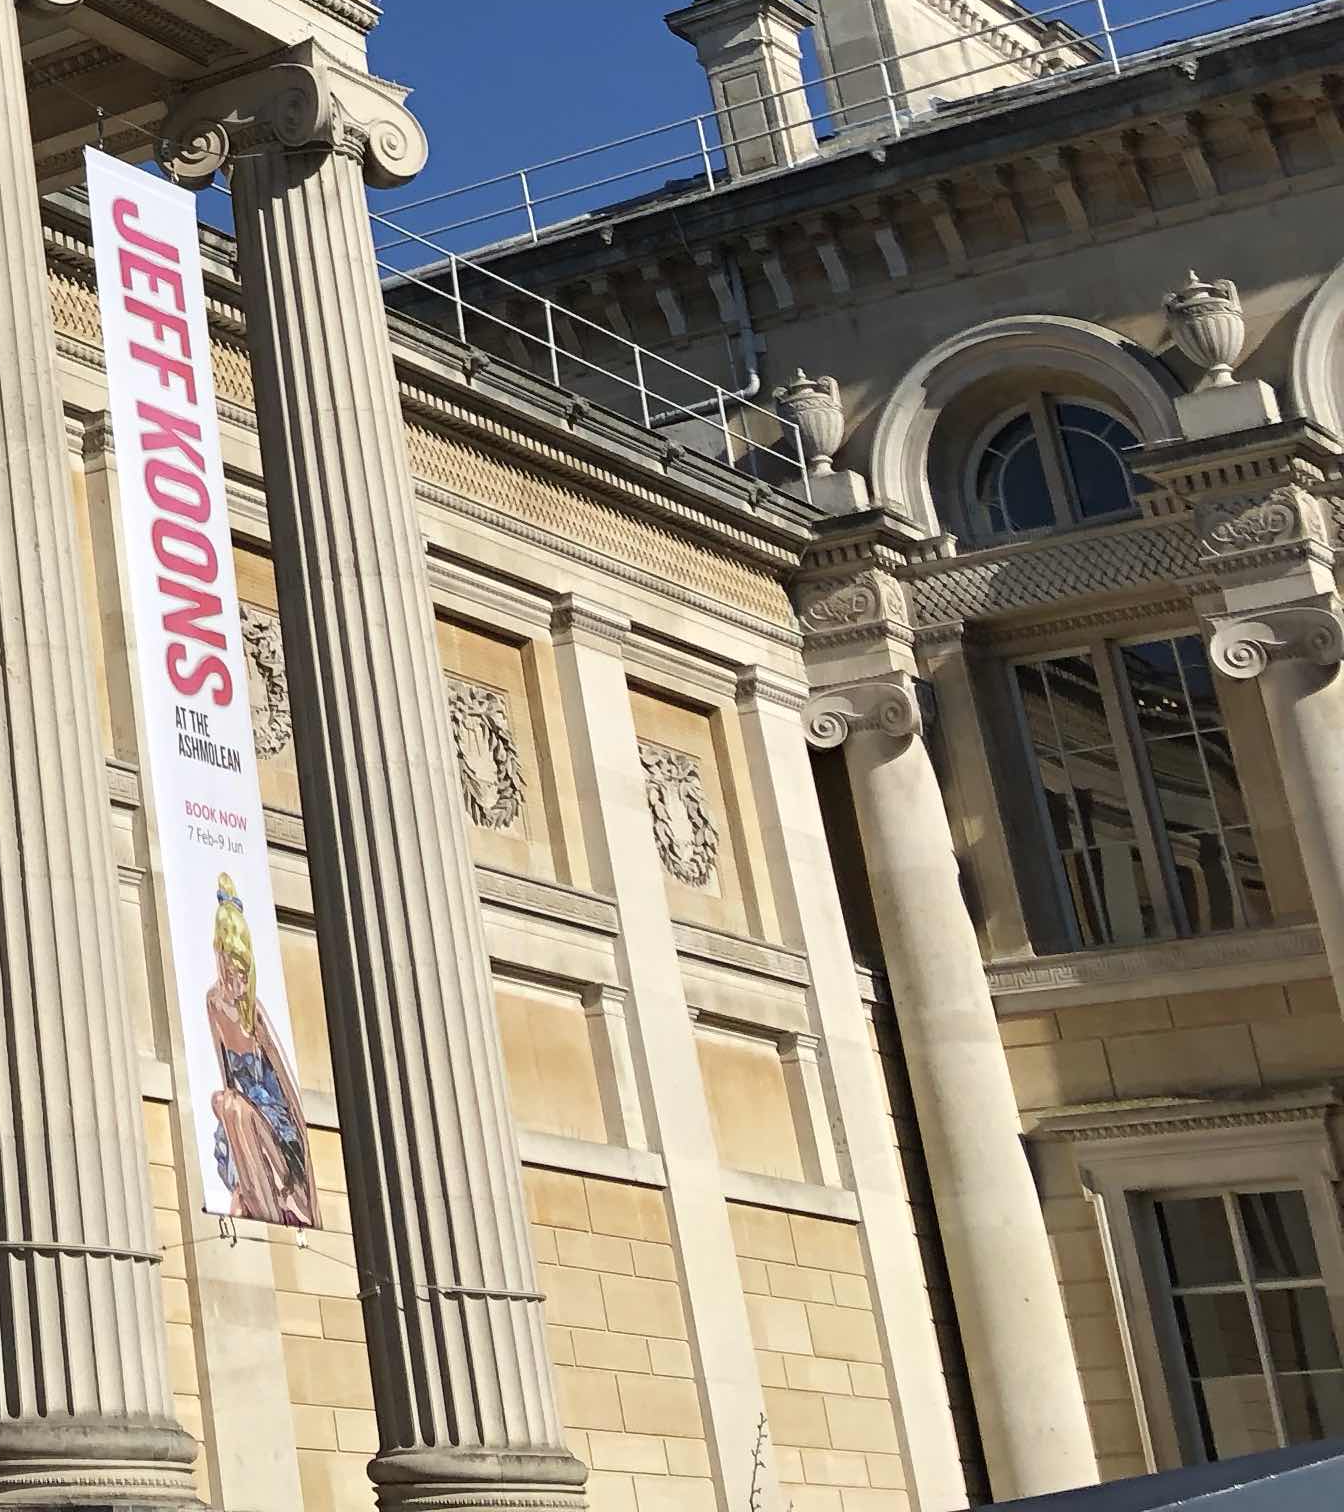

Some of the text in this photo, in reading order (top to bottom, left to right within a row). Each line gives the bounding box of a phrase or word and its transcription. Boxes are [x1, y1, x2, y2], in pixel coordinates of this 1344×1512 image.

[112, 197, 233, 706] JEFF KOONS
[175, 705, 210, 738] AT THE
[178, 733, 242, 774] ASHMOLEAN
[185, 800, 247, 832] BOOK NOW
[187, 825, 194, 840] 7
[228, 836, 244, 855] Jun
